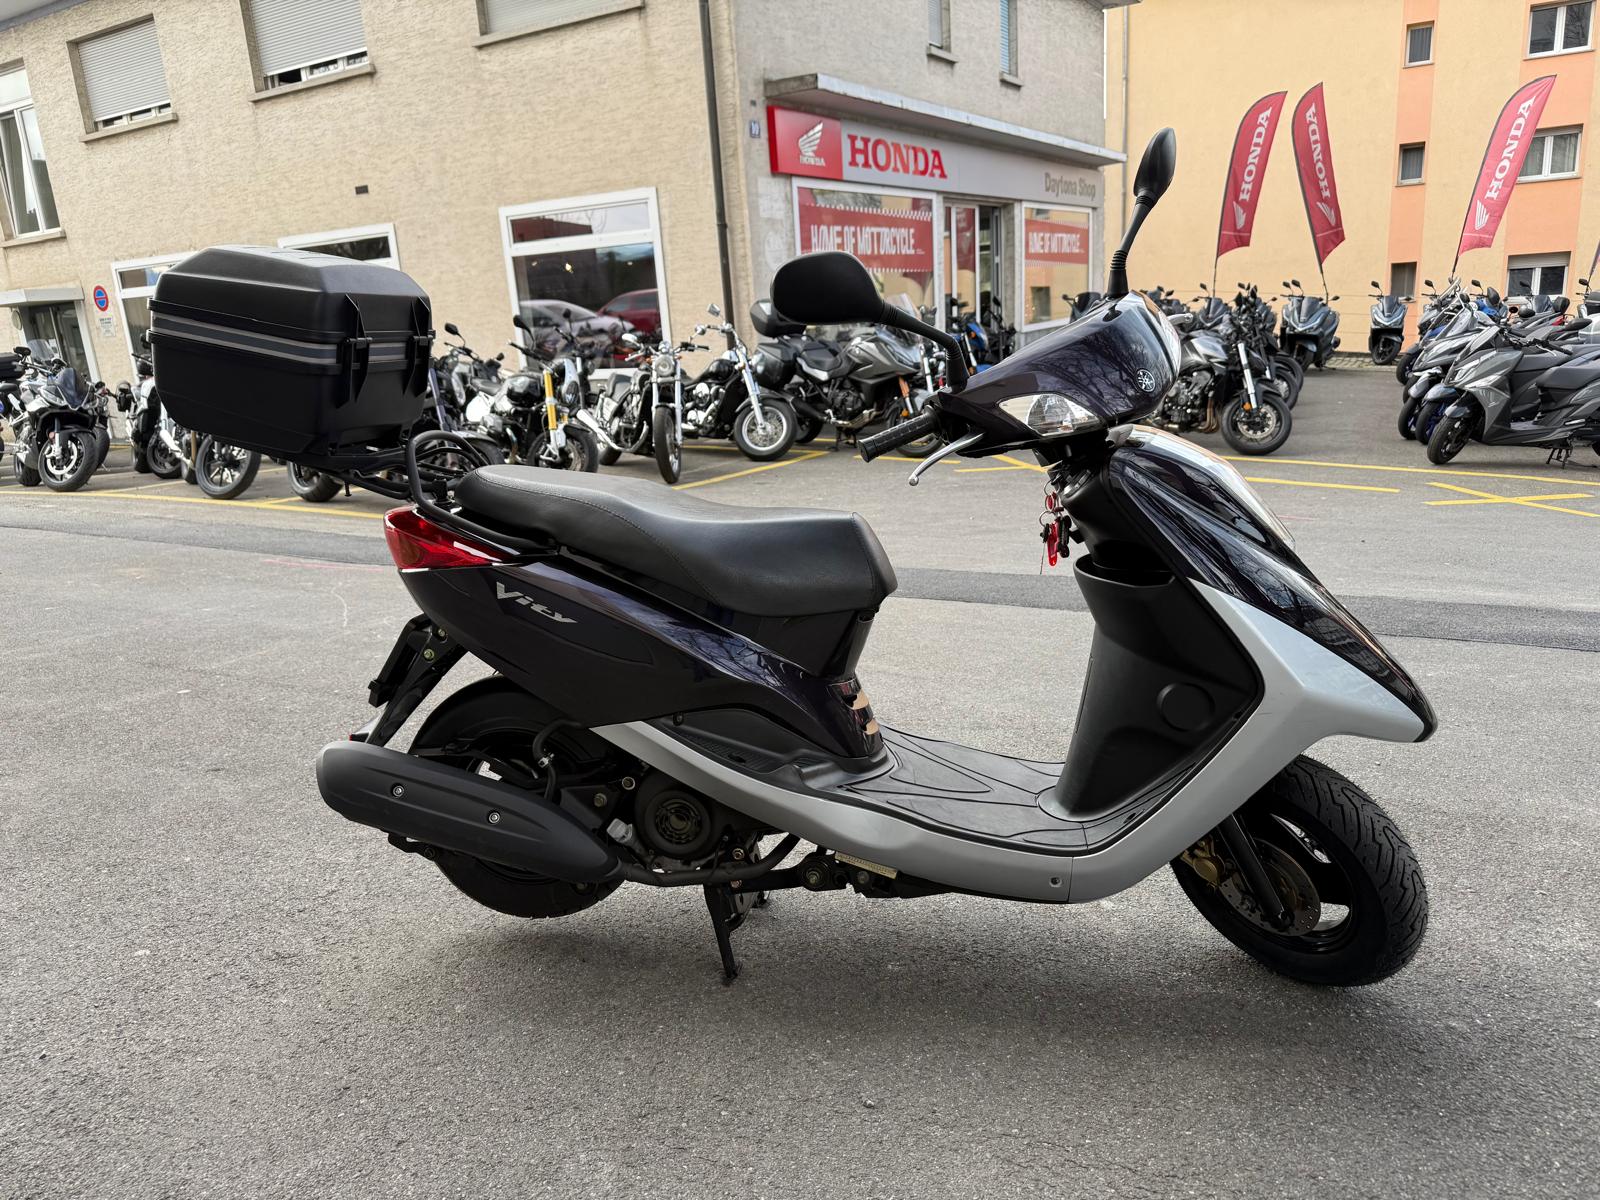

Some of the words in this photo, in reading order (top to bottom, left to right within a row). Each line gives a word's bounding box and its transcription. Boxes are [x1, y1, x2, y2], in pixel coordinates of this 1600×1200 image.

[800, 155, 826, 167] HONDA
[847, 134, 948, 179] HONDA
[1239, 106, 1272, 202] HONDA
[1306, 102, 1331, 199] HONDA
[1484, 95, 1536, 200] HONDA
[1044, 172, 1078, 198] Daytona
[1078, 177, 1096, 201] Shop
[810, 224, 842, 252] HOME
[843, 225, 856, 254] OF
[857, 227, 915, 255] MOTORCYCLE
[496, 581, 579, 624] Vity
